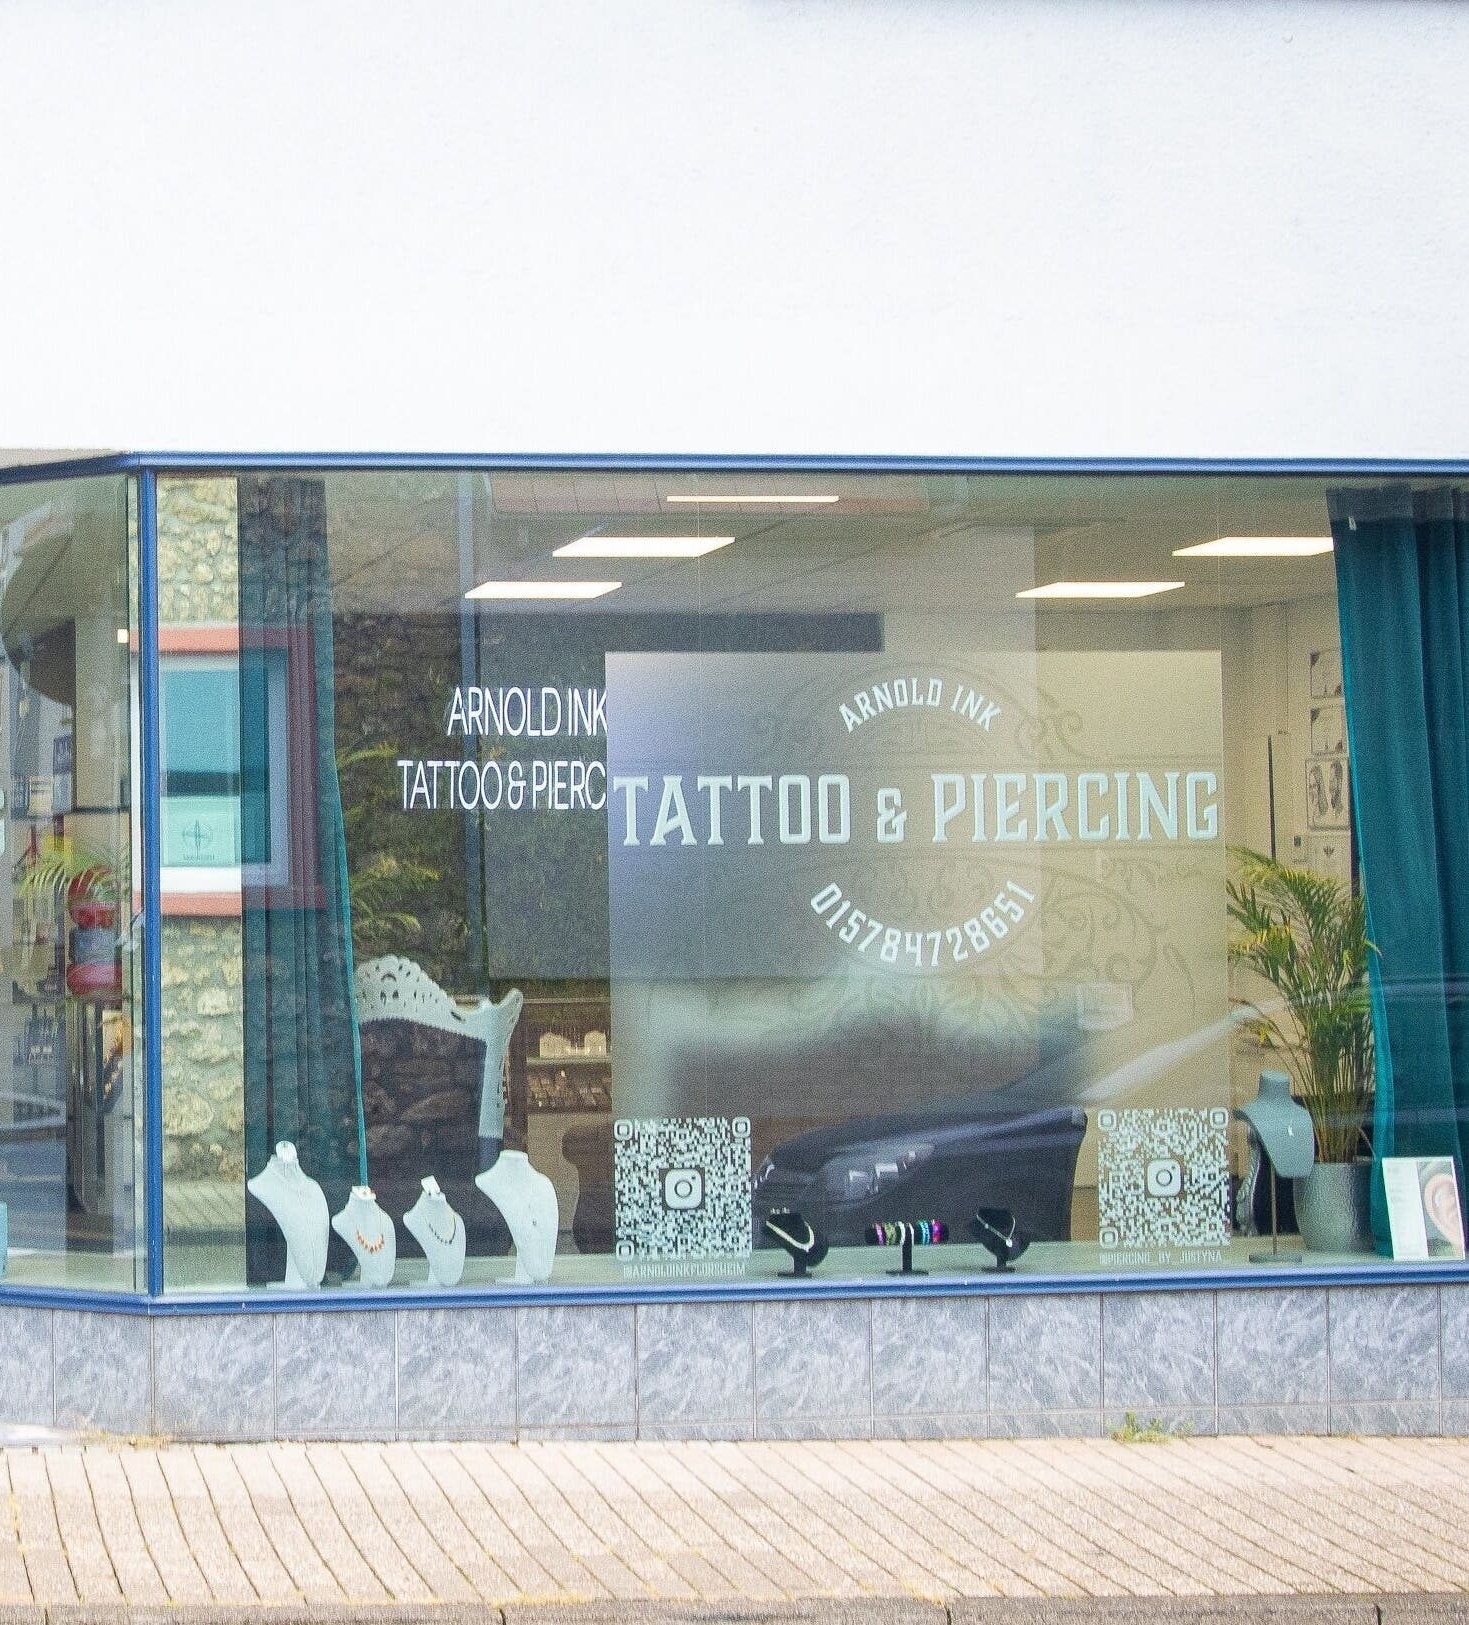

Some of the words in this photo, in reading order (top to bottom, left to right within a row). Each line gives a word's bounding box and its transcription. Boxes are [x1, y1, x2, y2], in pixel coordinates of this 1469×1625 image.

[447, 687, 561, 736] ARNOLD
[568, 687, 607, 736] INK
[838, 677, 943, 732] ARNOLD
[950, 684, 1002, 732] INK
[397, 760, 503, 810] TATTOO
[507, 760, 526, 810] &
[613, 774, 850, 846] TATTOO
[876, 788, 907, 843] &
[932, 771, 1219, 843] PIERCING
[810, 880, 1036, 967] 015784728651
